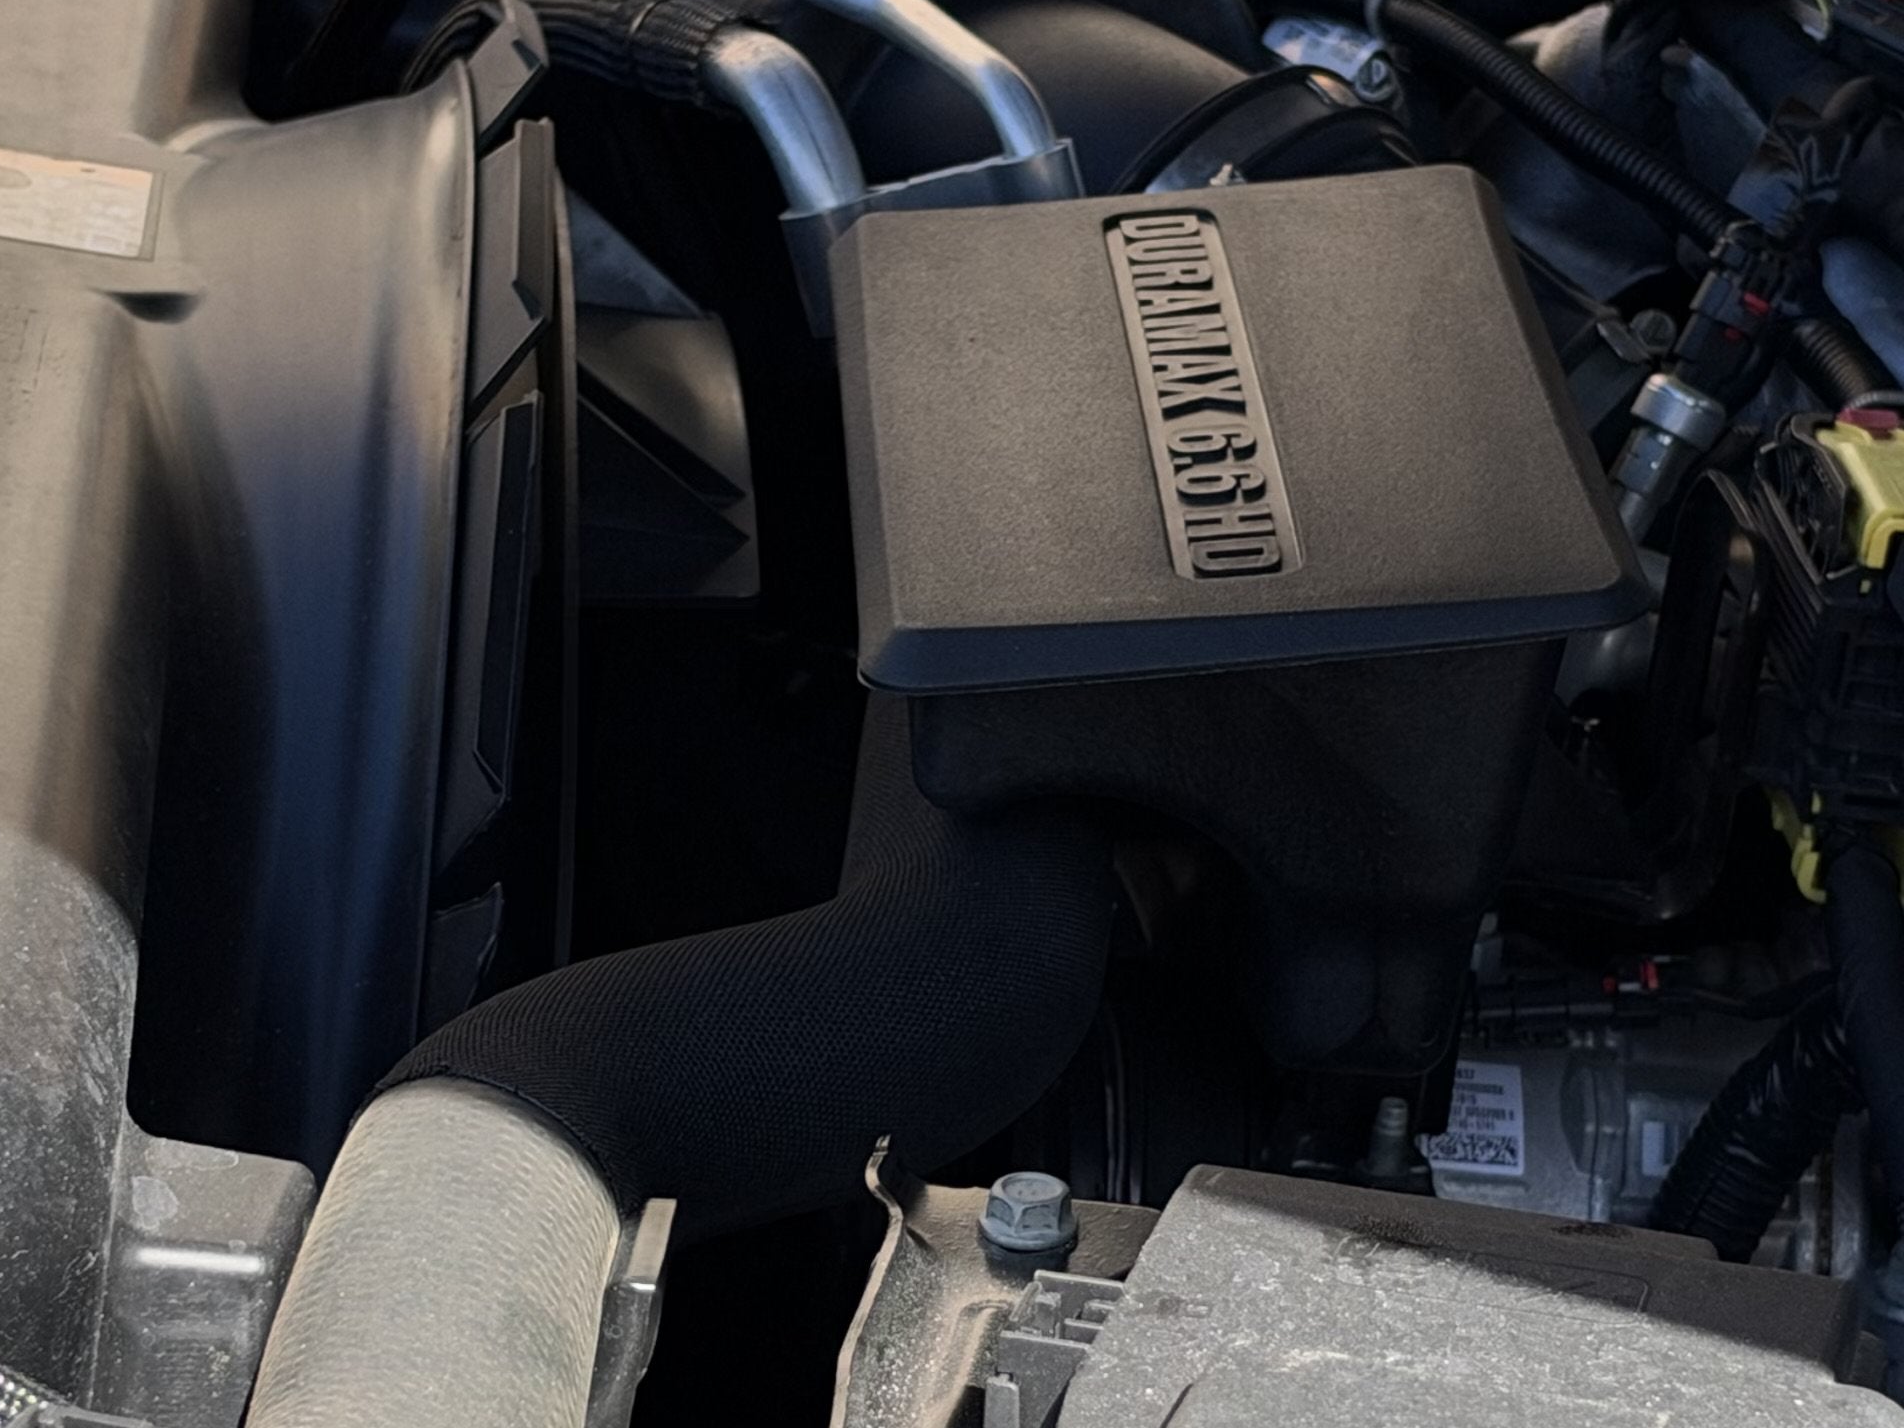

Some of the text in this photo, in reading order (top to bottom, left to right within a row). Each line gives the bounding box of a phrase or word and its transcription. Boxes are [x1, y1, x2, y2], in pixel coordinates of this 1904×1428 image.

[1118, 213, 1284, 576] DURAMAX 6.6 HD
